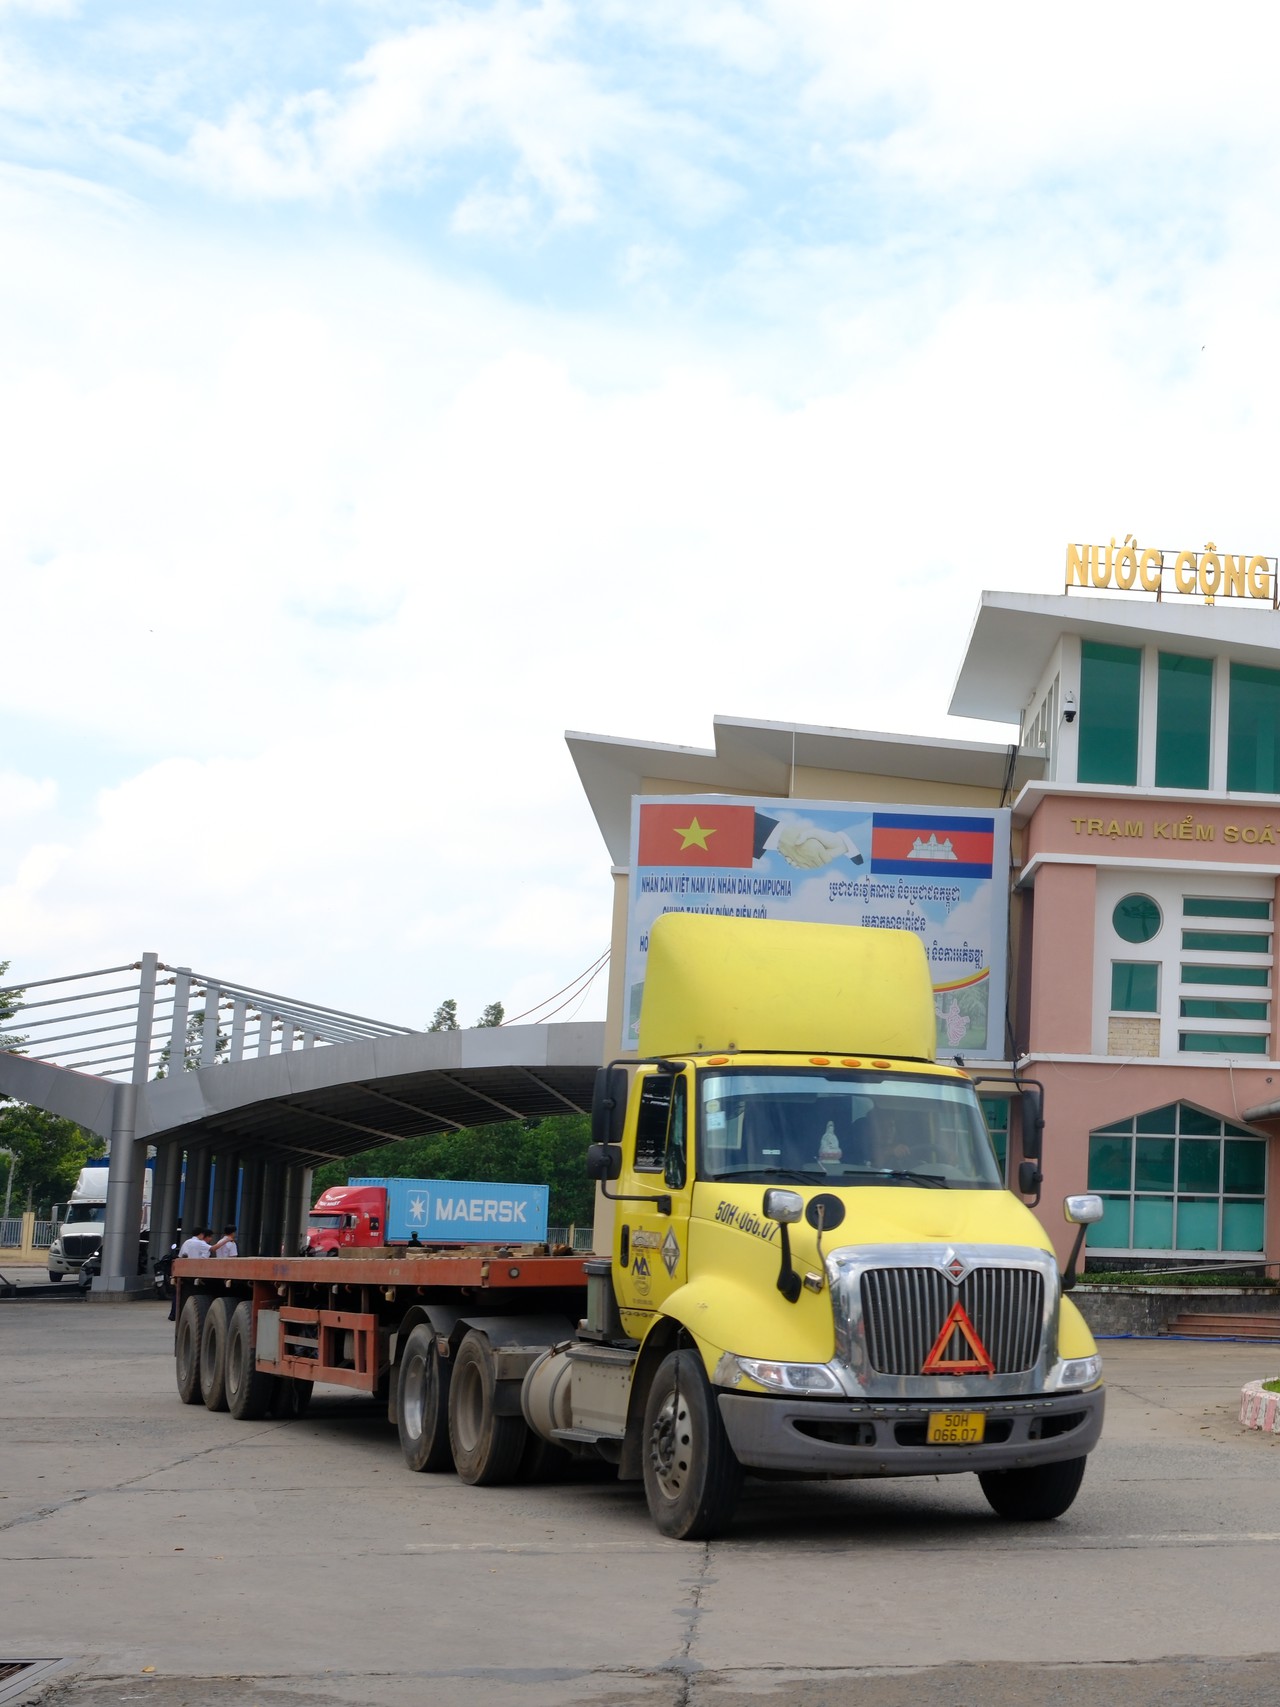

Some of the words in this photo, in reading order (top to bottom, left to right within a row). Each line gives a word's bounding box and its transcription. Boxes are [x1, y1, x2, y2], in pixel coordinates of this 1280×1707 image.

[1066, 533, 1163, 591] NƯỚC
[1174, 541, 1269, 604] CỘNG
[1071, 817, 1143, 841] TRẠM
[1153, 814, 1215, 842] KIỂM
[641, 873, 660, 893] NHÂN
[660, 873, 674, 893] DÂN
[675, 873, 690, 898] VIỆT
[690, 877, 706, 894] NAM
[707, 873, 716, 894] VÀ
[717, 874, 737, 895] NHÂN
[738, 875, 752, 895] DÂN
[753, 878, 792, 897] CAMPUCHIA
[435, 1198, 528, 1223] MAERSK
[945, 1414, 969, 1427] 50H
[934, 1428, 977, 1441] 066.07
